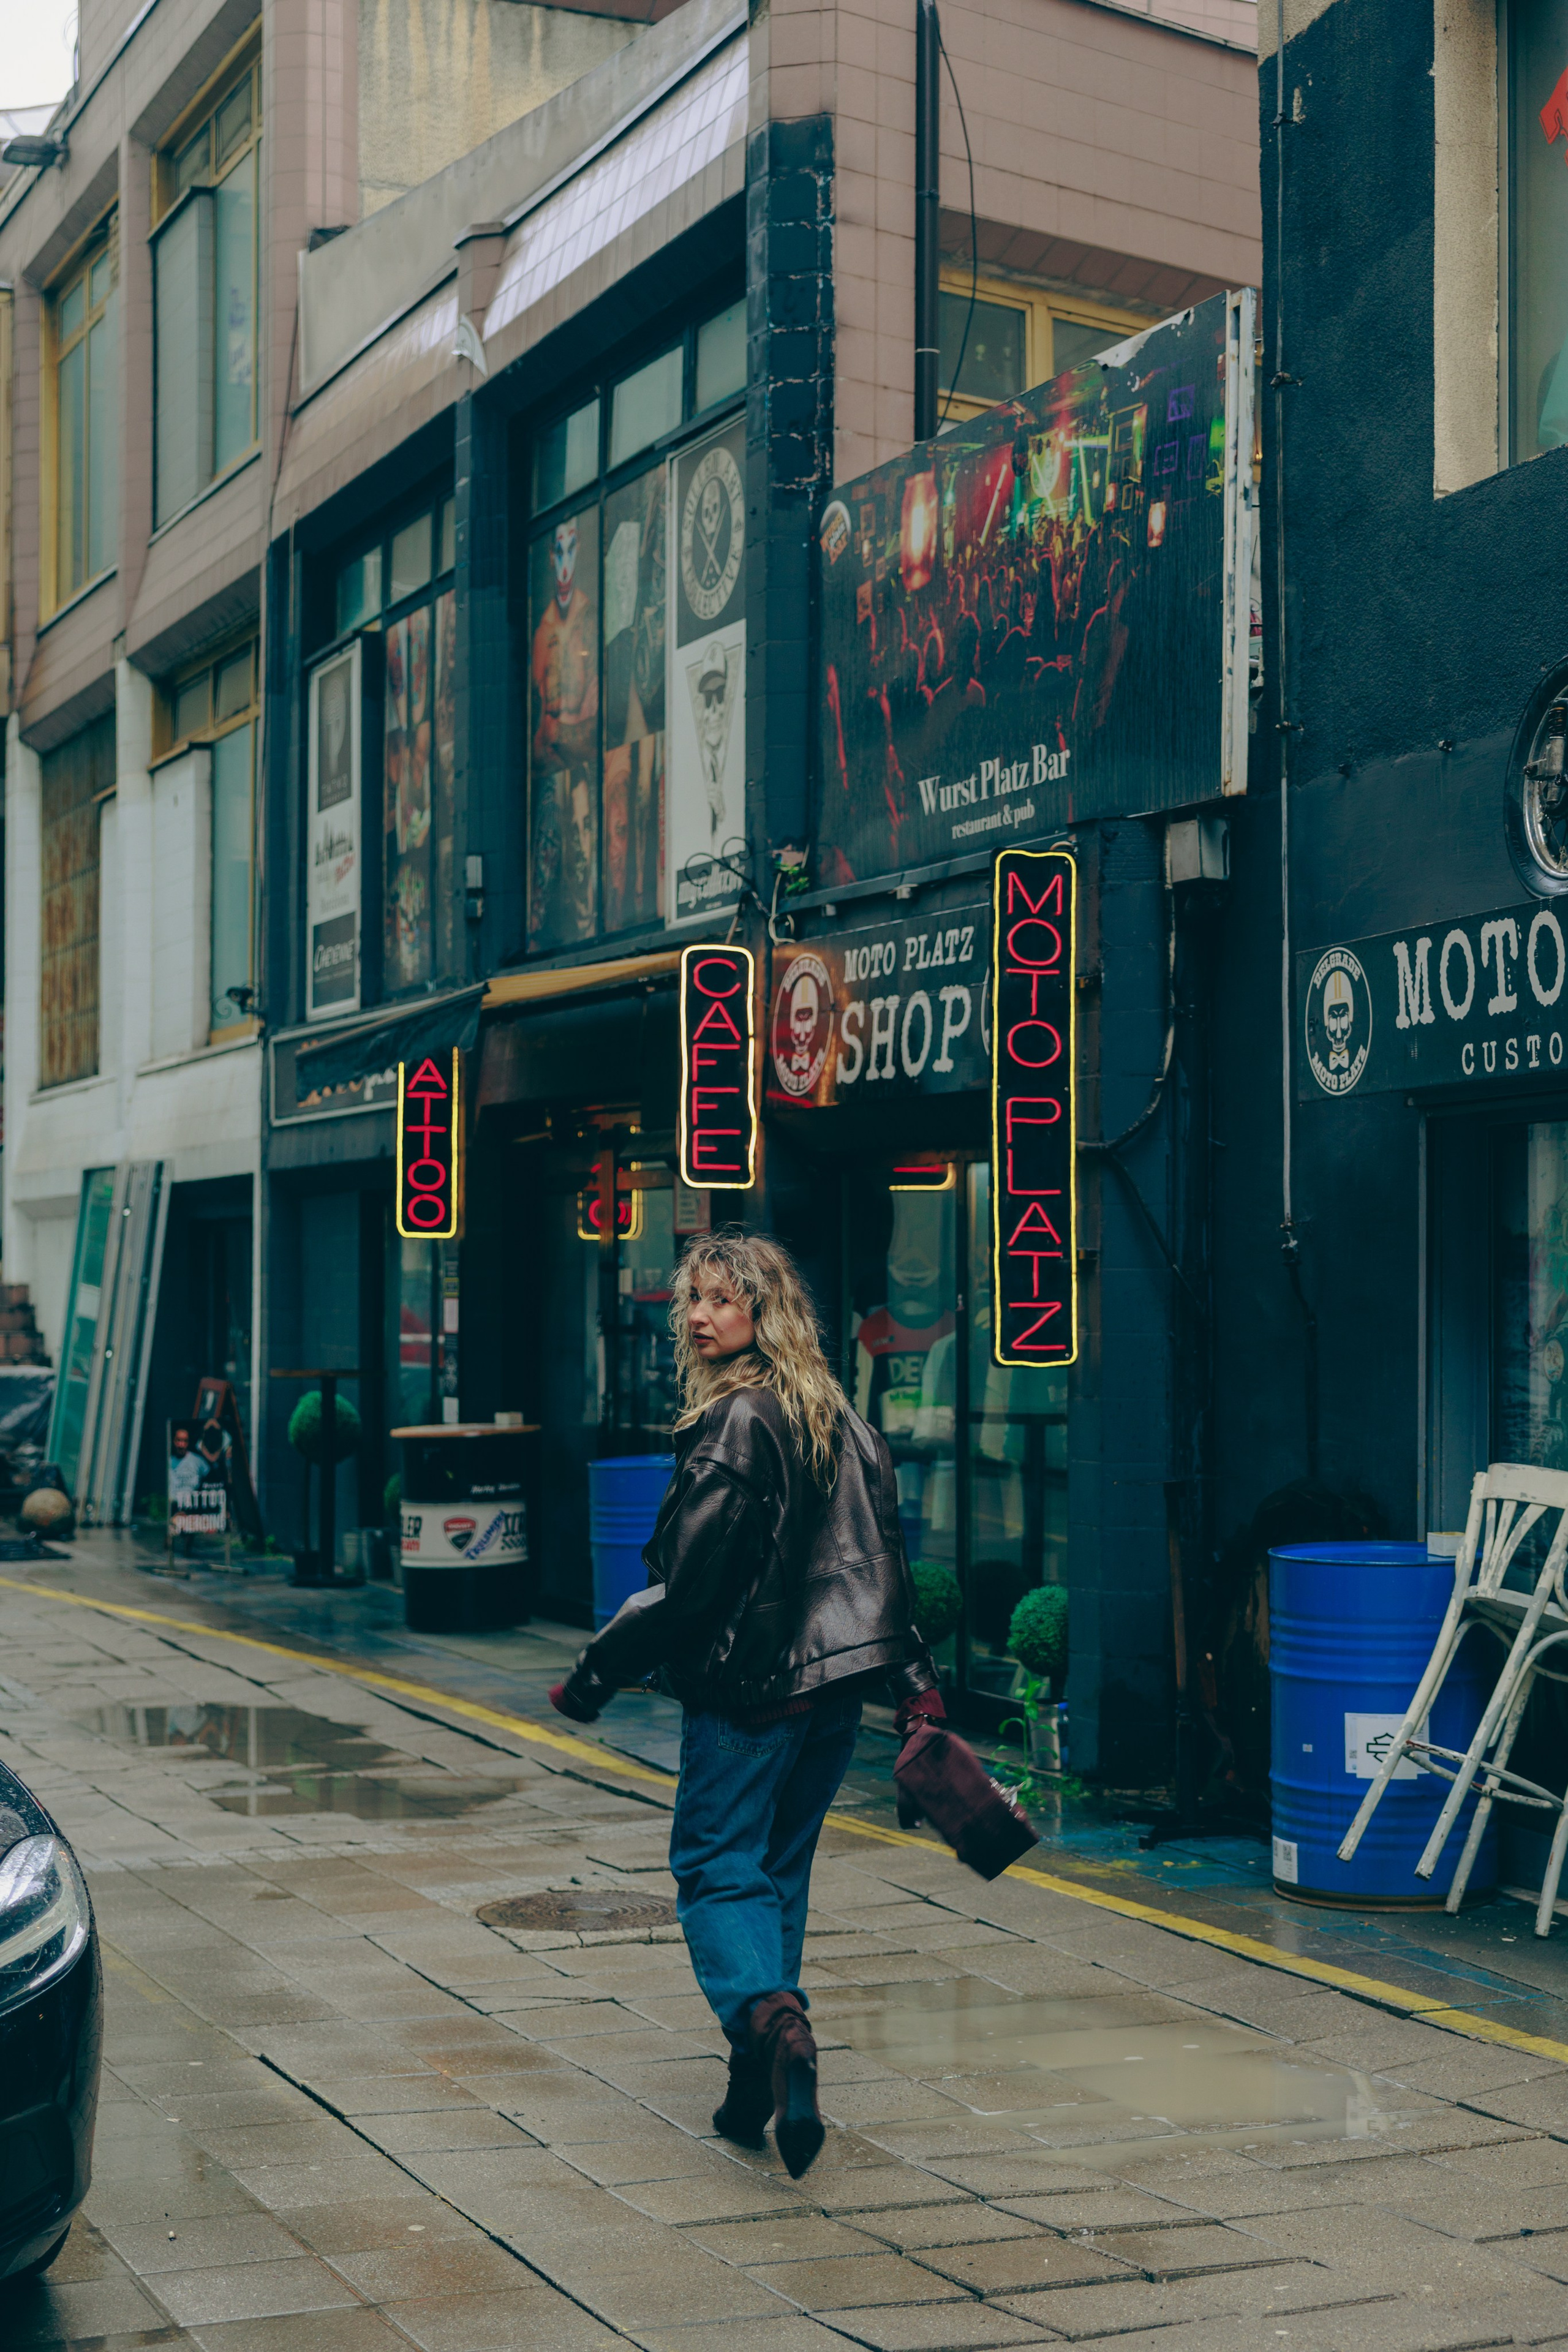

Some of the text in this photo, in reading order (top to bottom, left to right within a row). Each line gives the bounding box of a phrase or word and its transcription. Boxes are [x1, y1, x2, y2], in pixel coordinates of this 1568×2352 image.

[918, 743, 1071, 816] Wurst Platz Bar
[952, 798, 1035, 839] restaurant & pub
[843, 925, 974, 983] MOTO PLATZ
[1313, 952, 1361, 990] BELGRADE
[1393, 910, 1566, 1030] MOTO
[692, 957, 741, 1170] CAFFE
[835, 984, 972, 1085] SHOP
[1461, 1031, 1563, 1075] CUSTO
[1311, 1044, 1366, 1090] MOTO PLATZ
[1005, 871, 1066, 1351] MOTO PLATZ
[406, 1057, 447, 1227] ATTOO
[888, 1355, 924, 1384] DE
[176, 1489, 226, 1510] TATTOO
